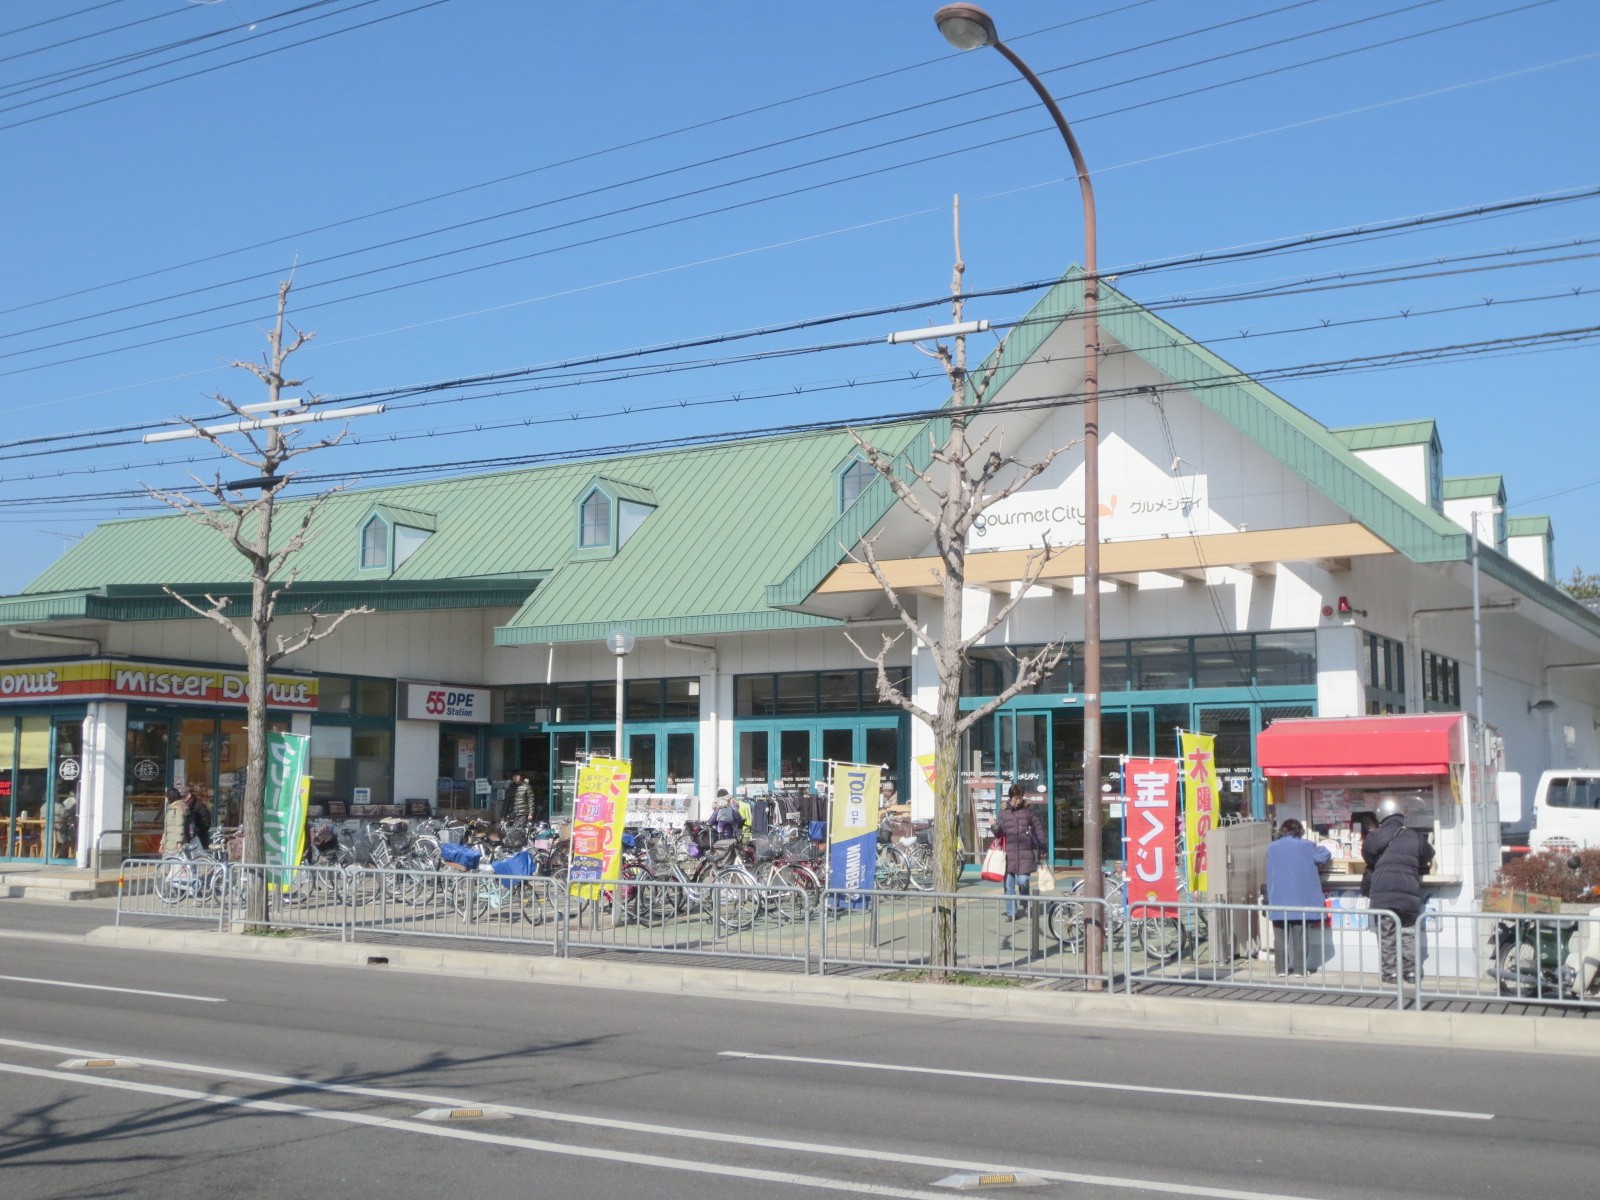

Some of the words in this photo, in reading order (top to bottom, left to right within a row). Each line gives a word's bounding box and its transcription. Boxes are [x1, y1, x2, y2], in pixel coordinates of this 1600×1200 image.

[1129, 497, 1202, 515] グルメシティ
[115, 669, 215, 697] Mister
[222, 675, 312, 704] Dnut
[425, 690, 446, 715] 55
[446, 692, 475, 707] DPE
[446, 706, 473, 717] Station
[1132, 771, 1170, 882] 宝くじ
